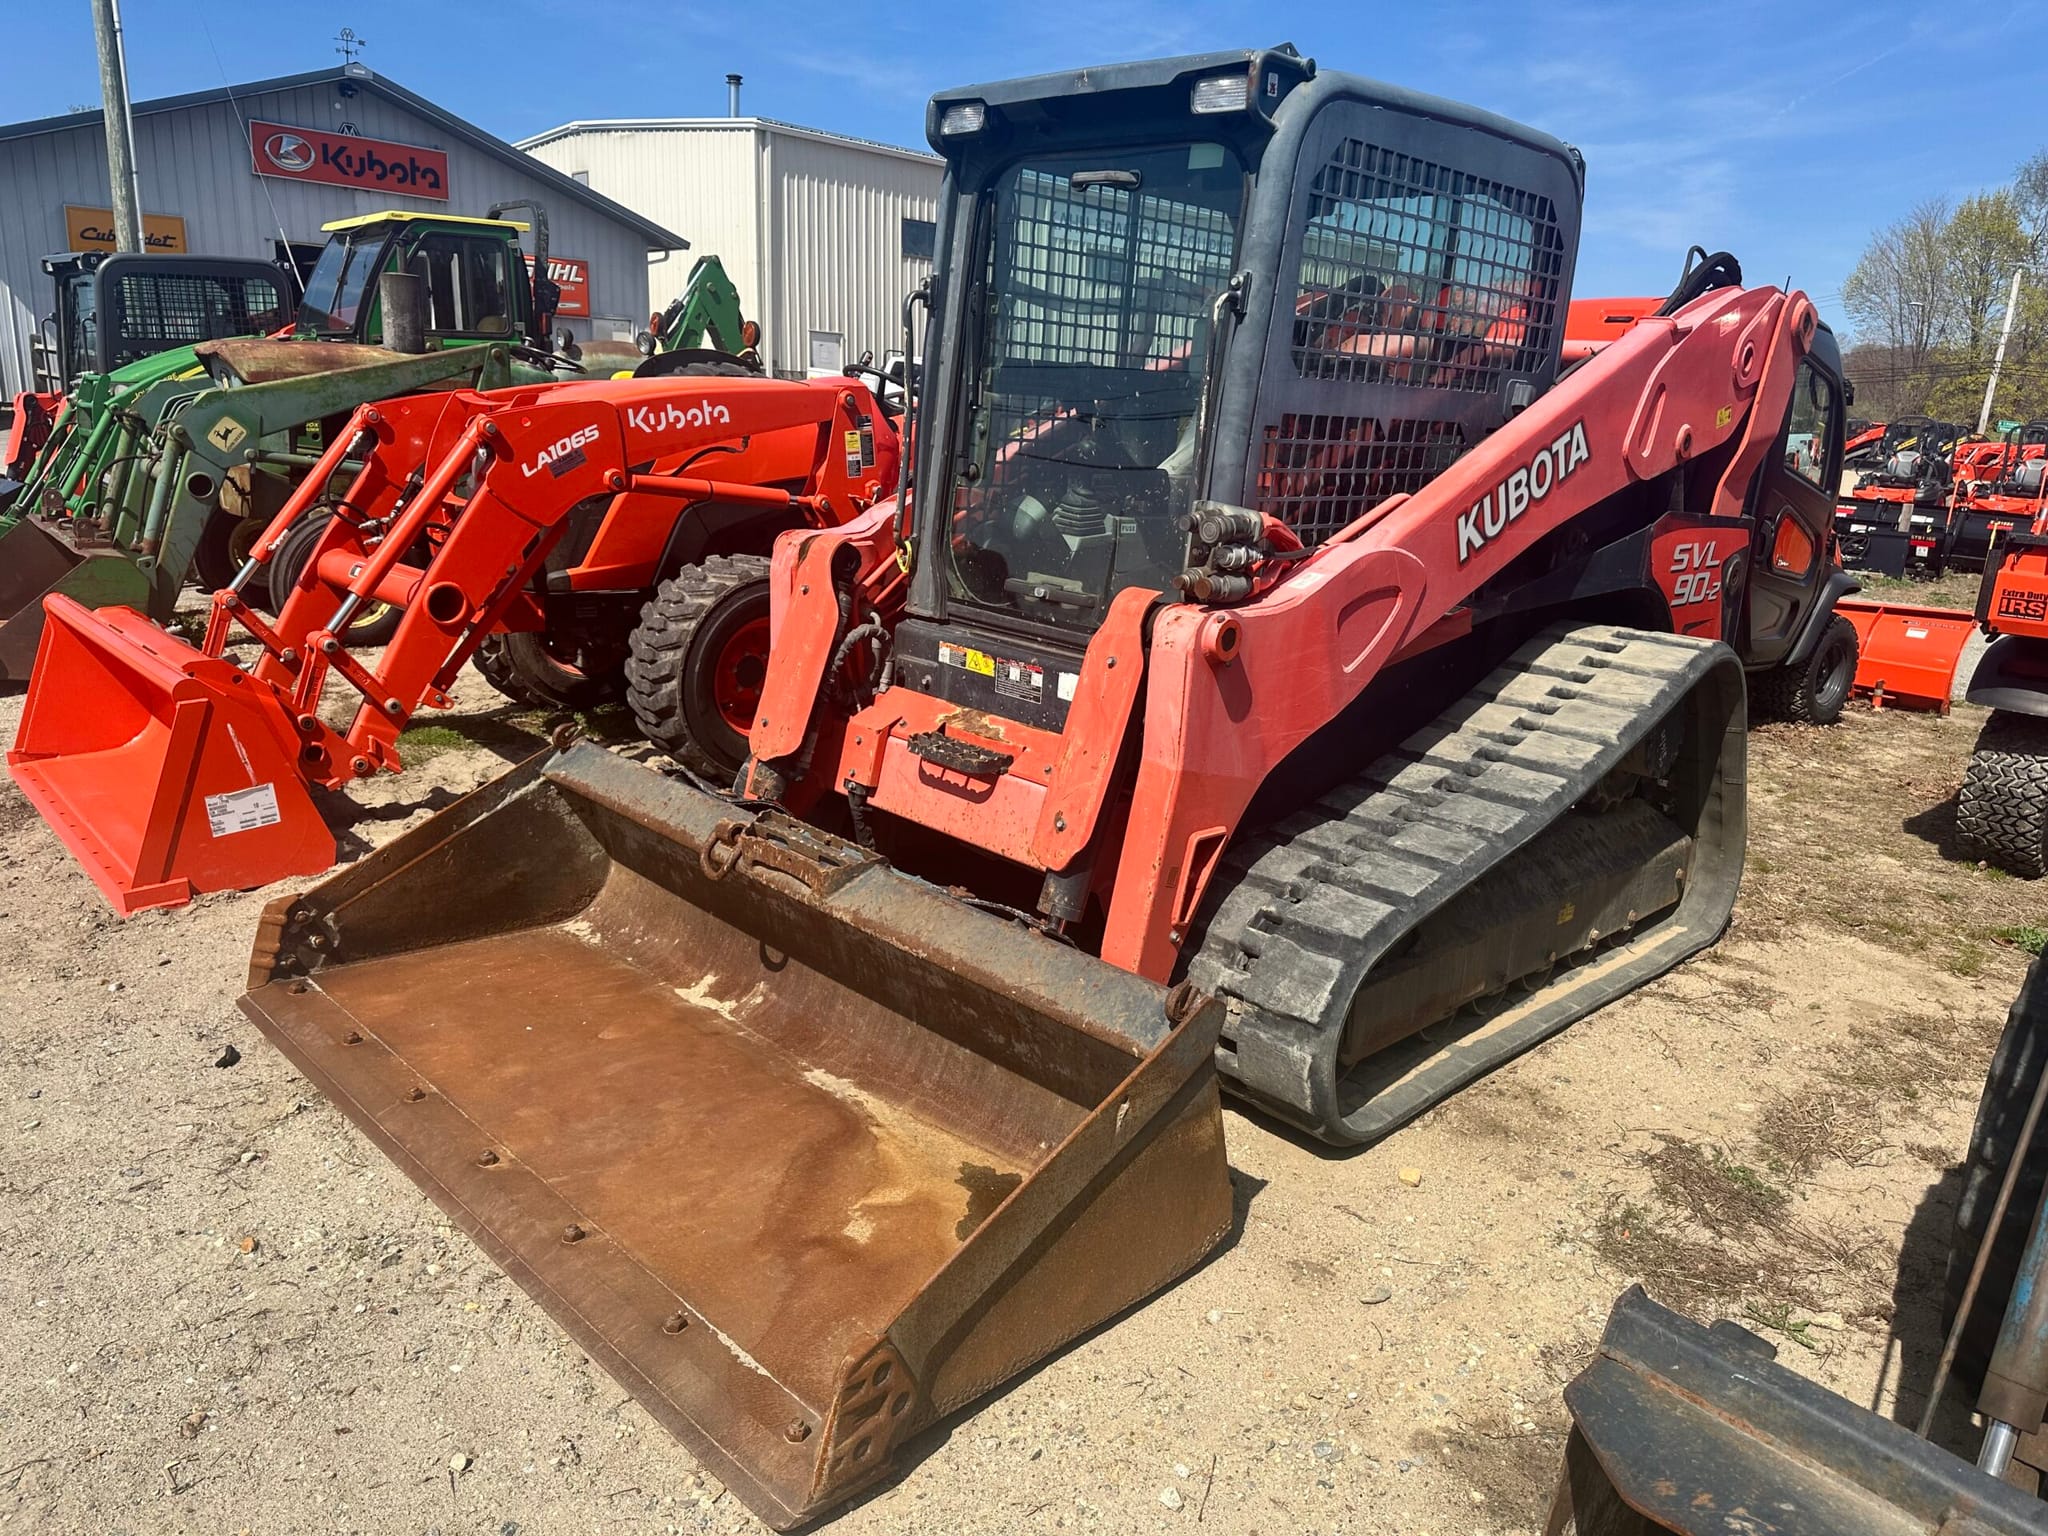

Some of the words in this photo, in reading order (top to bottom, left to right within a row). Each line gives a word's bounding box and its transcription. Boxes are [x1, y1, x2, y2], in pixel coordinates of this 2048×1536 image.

[321, 142, 441, 189] Kubota
[145, 233, 177, 248] det
[627, 399, 730, 433] Kubota
[521, 423, 600, 478] LA1065
[1456, 420, 1590, 563] KUBOTA
[1670, 541, 1721, 573] SVL
[1670, 571, 1721, 608] 90-2
[2002, 589, 2025, 599] Extra
[2000, 599, 2046, 615] IRS
